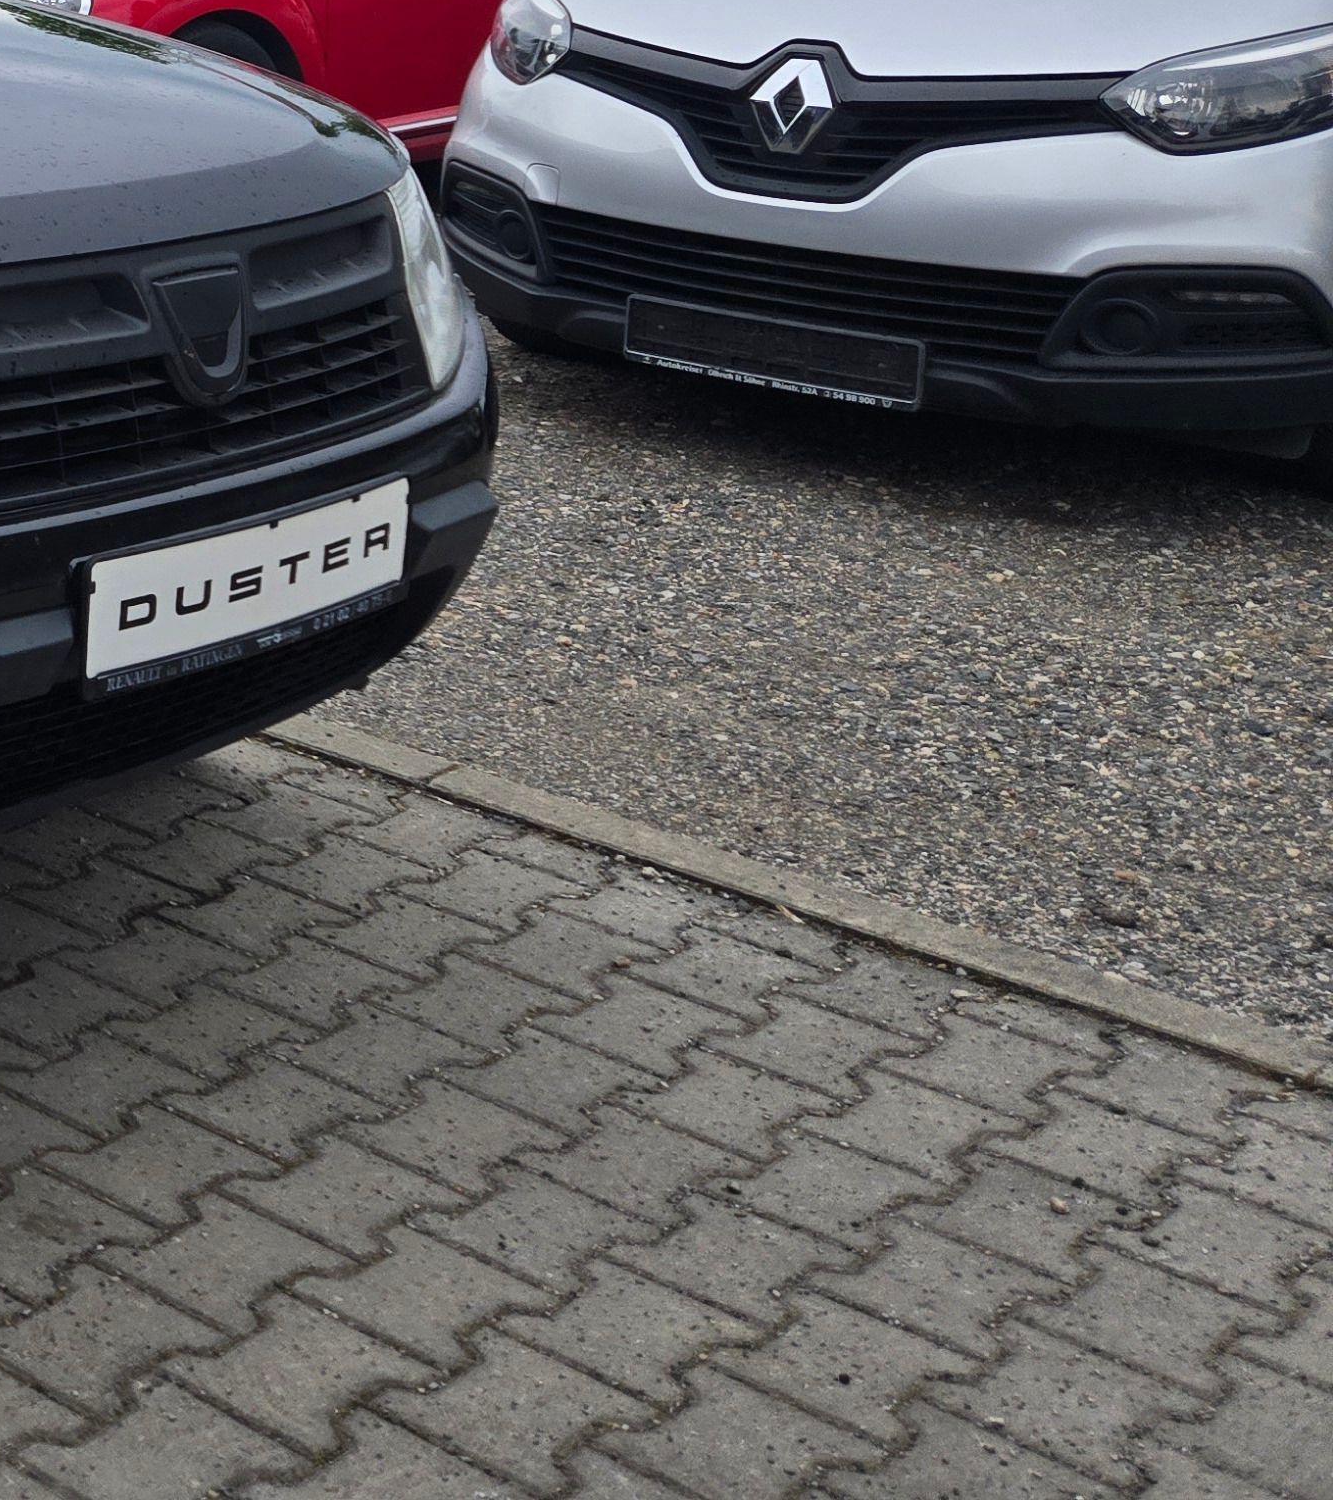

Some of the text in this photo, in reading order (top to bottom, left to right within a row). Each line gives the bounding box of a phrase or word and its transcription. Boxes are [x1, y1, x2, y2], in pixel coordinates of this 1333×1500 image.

[801, 386, 818, 396] 52A
[832, 391, 844, 401] 54
[858, 396, 876, 405] 900
[118, 522, 390, 631] DUSTER
[105, 665, 164, 693] RENAULT
